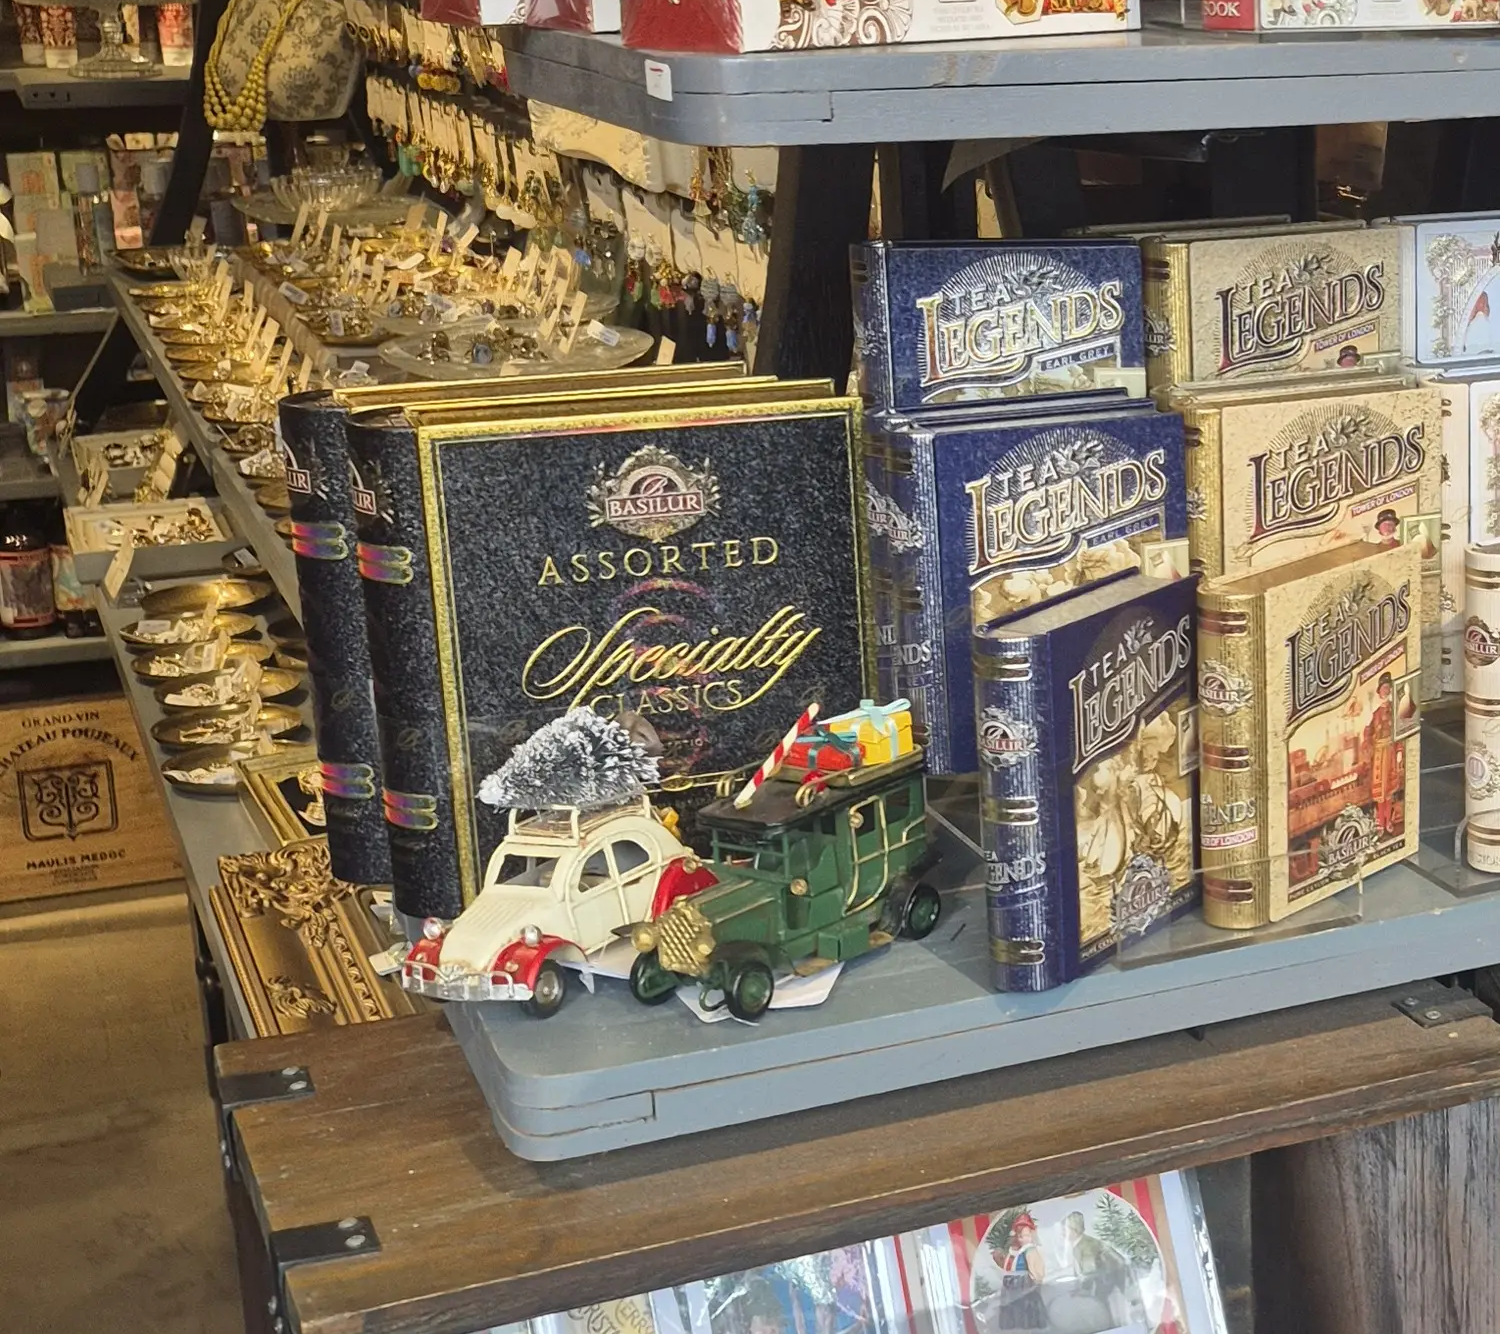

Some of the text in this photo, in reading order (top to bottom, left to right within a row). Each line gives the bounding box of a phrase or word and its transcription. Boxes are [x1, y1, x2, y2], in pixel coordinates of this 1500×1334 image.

[954, 283, 1010, 316] TEA
[1246, 272, 1291, 301] TEA
[916, 279, 1125, 389] LEGENDS
[1216, 260, 1385, 375] LEGENDS
[1315, 336, 1339, 352] TOWER
[1348, 322, 1376, 342] LONDON
[1045, 347, 1113, 371] EARL GREY
[1278, 436, 1326, 470] TEA
[1001, 464, 1051, 498] TEA
[1250, 421, 1426, 544] LEGENDS
[1388, 485, 1417, 503] LONDON
[607, 492, 705, 519] BASILUR
[965, 449, 1167, 575] LEGENDS
[1091, 516, 1160, 546] EARL GREY
[538, 536, 781, 586] ASSORTED
[1303, 602, 1346, 646] TEA
[520, 604, 823, 712] Specialty
[1091, 643, 1127, 687] TEA
[1285, 579, 1410, 724] LEGENDS
[1069, 614, 1191, 774] LEGENDS
[61, 727, 140, 761] POUJEAUX
[1223, 830, 1256, 846] LONDON
[1328, 836, 1369, 863] BASILUR
[26, 848, 127, 871] MAULIS MEDOC
[1121, 887, 1164, 919] BASILUR
